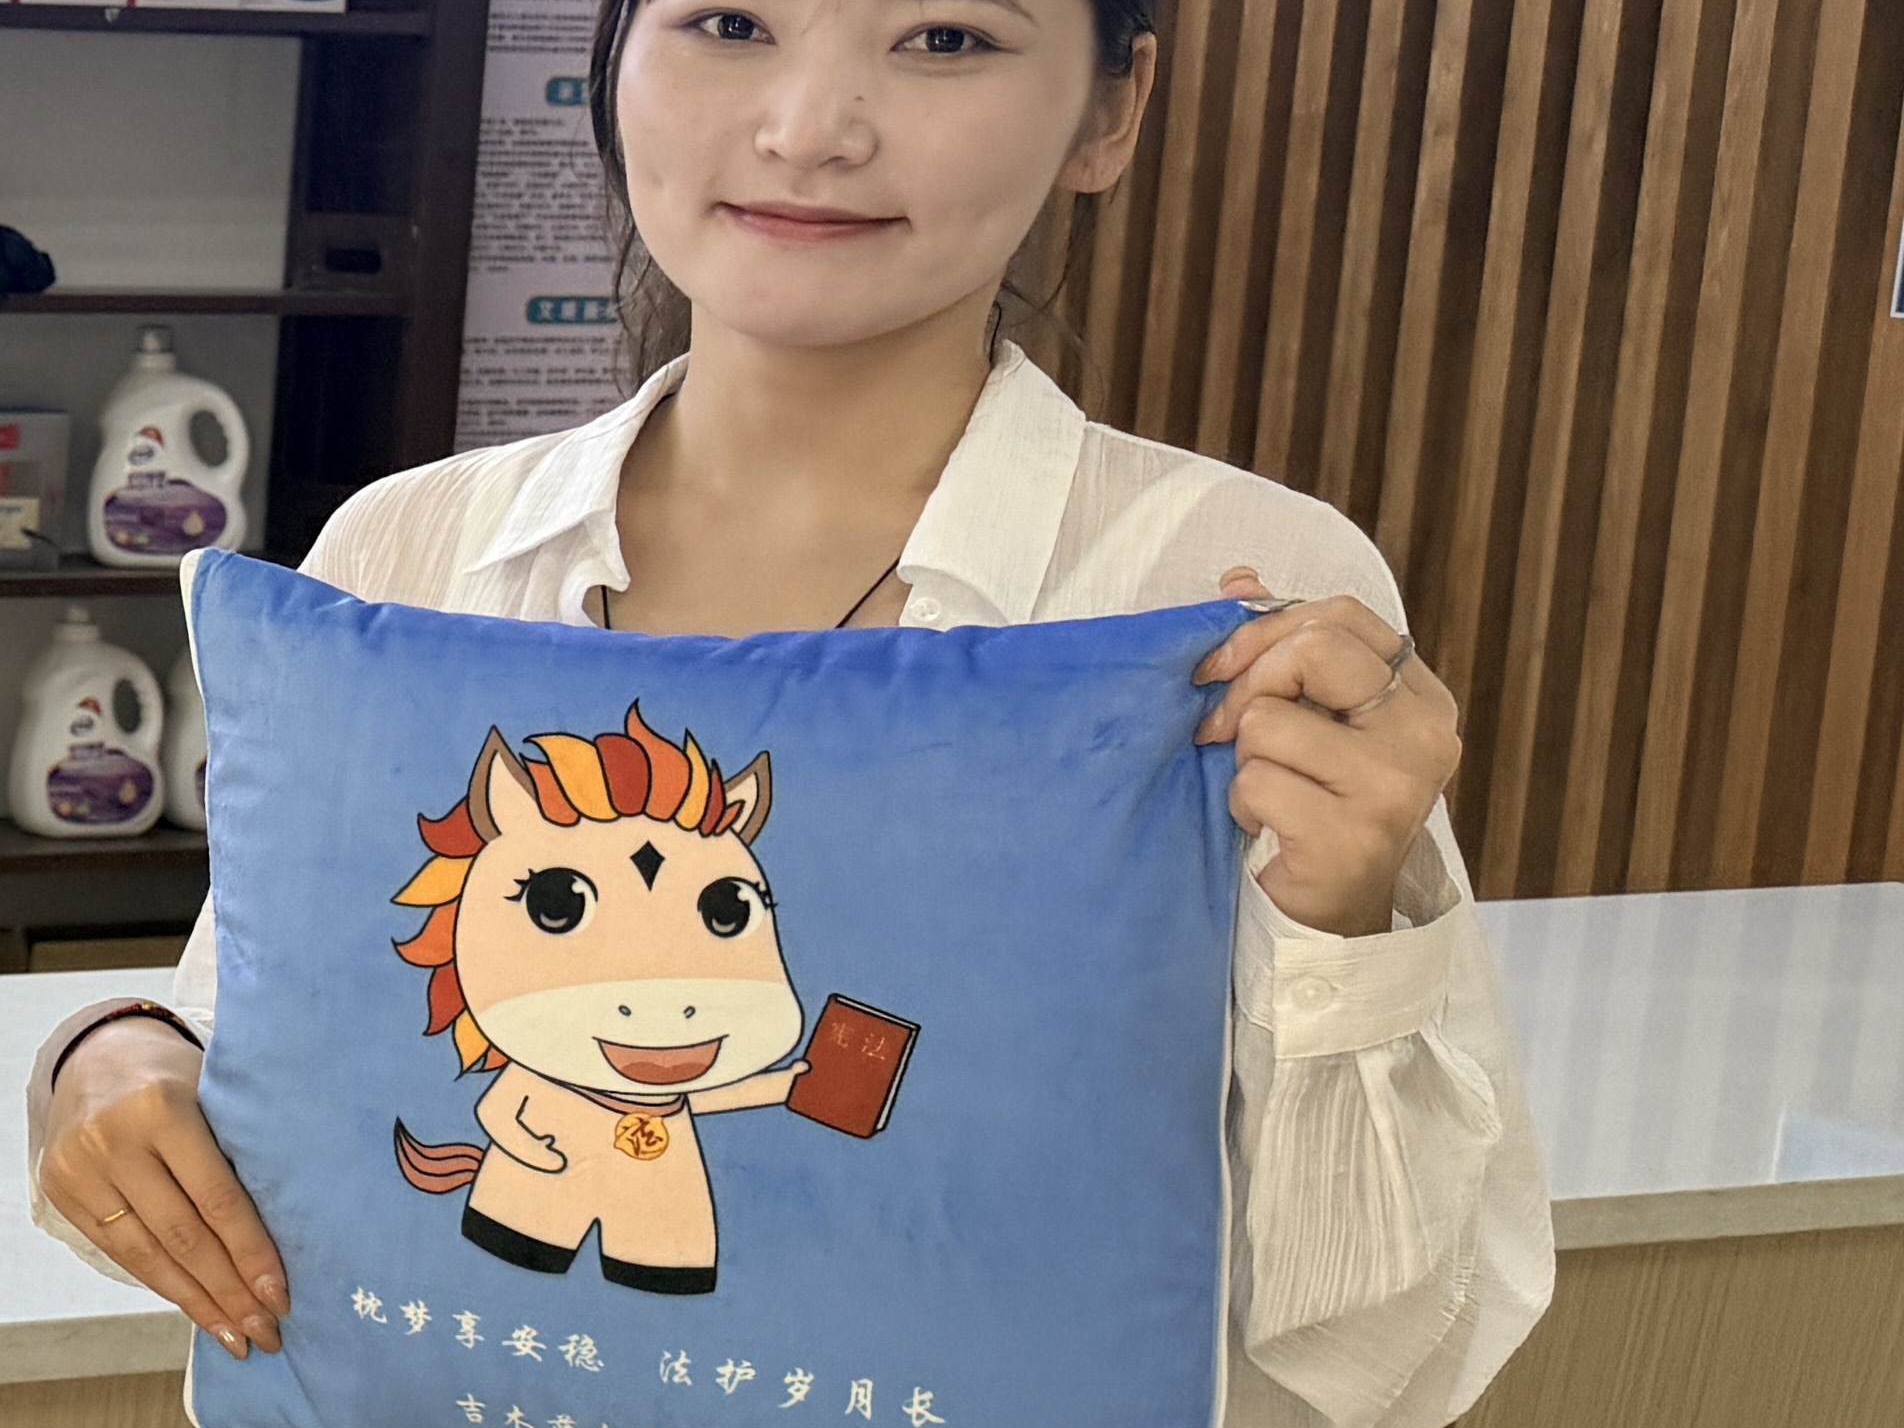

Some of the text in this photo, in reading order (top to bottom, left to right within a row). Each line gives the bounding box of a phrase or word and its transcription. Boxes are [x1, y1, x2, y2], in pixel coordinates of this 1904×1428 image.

[350, 1285, 946, 1427] 枕梦享安稳 法护岁月长
